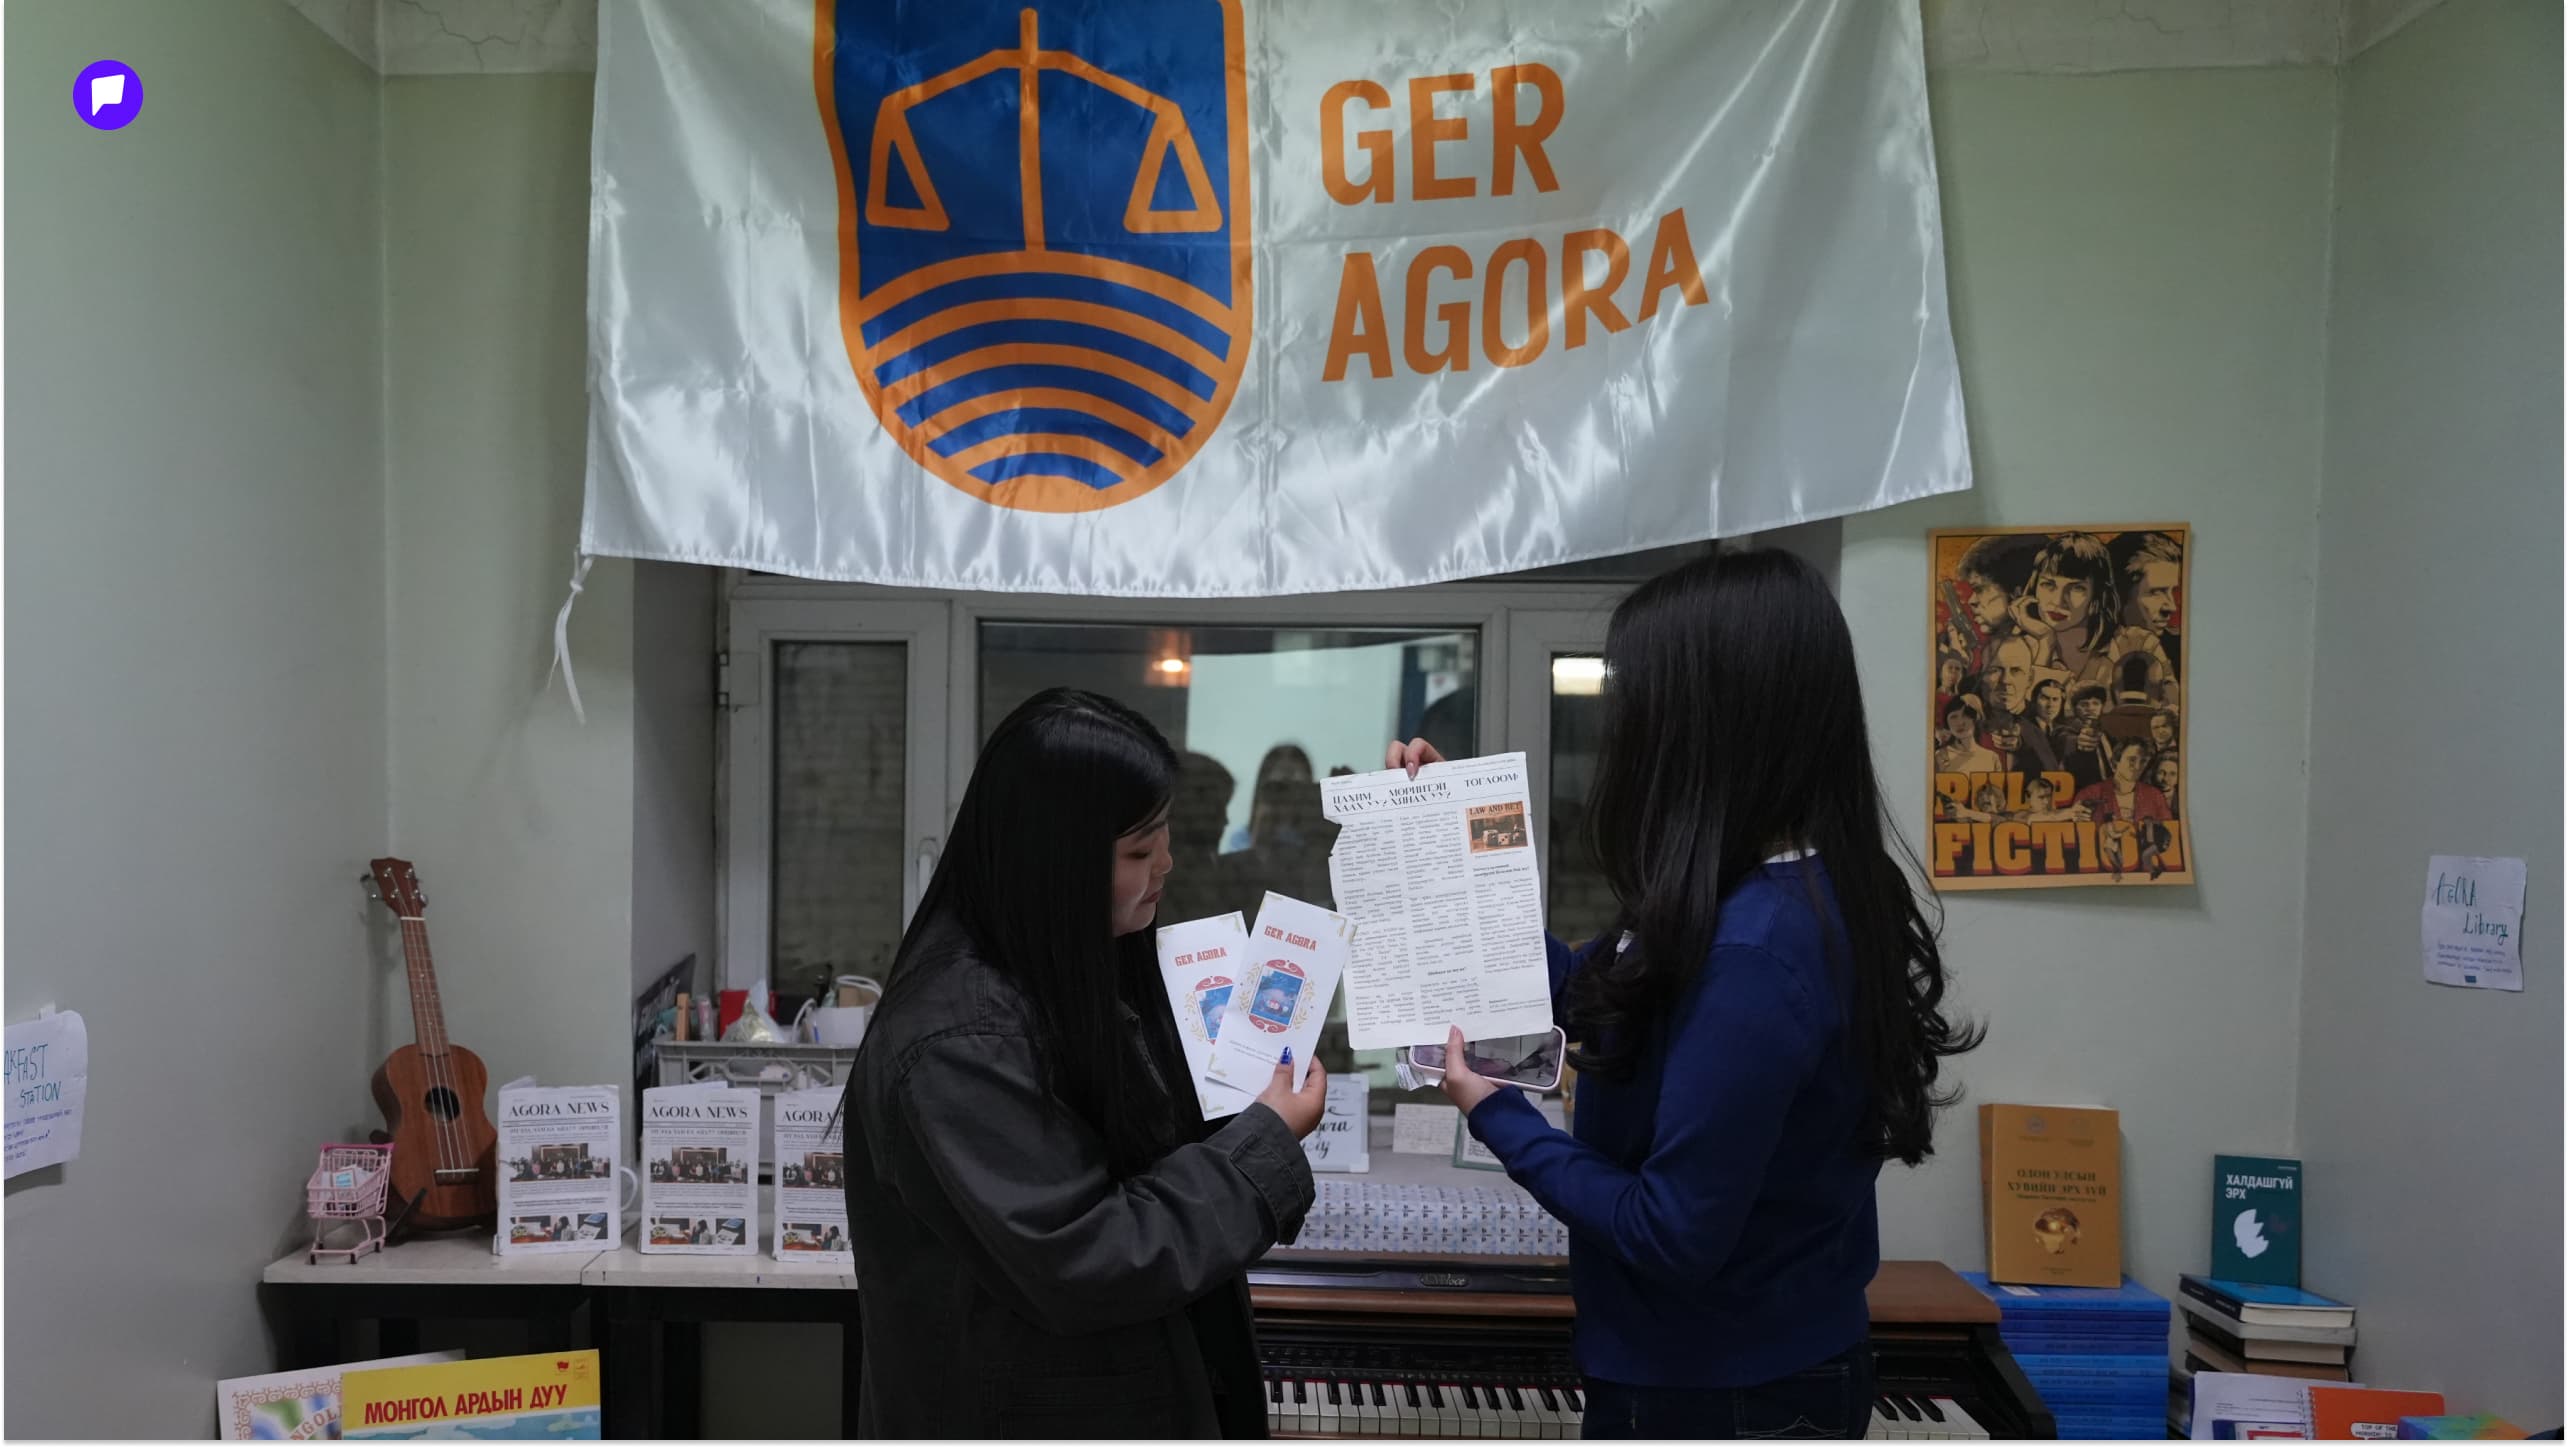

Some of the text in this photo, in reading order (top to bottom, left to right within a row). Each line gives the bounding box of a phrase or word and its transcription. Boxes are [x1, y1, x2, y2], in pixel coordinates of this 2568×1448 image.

[1319, 62, 1565, 206] GER
[1321, 206, 1710, 382] AGORA
[1935, 772, 2075, 820] PULP
[1469, 806, 1486, 816] LAW
[1488, 804, 1503, 813] AND
[1934, 822, 2186, 876] FICTION
[1264, 925, 1318, 952] GER AGORA
[2462, 911, 2509, 946] Library
[1174, 946, 1227, 967] GER AGORA
[509, 1101, 610, 1118] AGORA NEWS
[650, 1105, 749, 1119] AGORA NEWS
[2225, 1187, 2247, 1200] ЭРХ
[2226, 1173, 2294, 1190] ХАЛДАШГҮЙ
[364, 1383, 568, 1426] МОНГОЛ АРДЫН ДУУ
